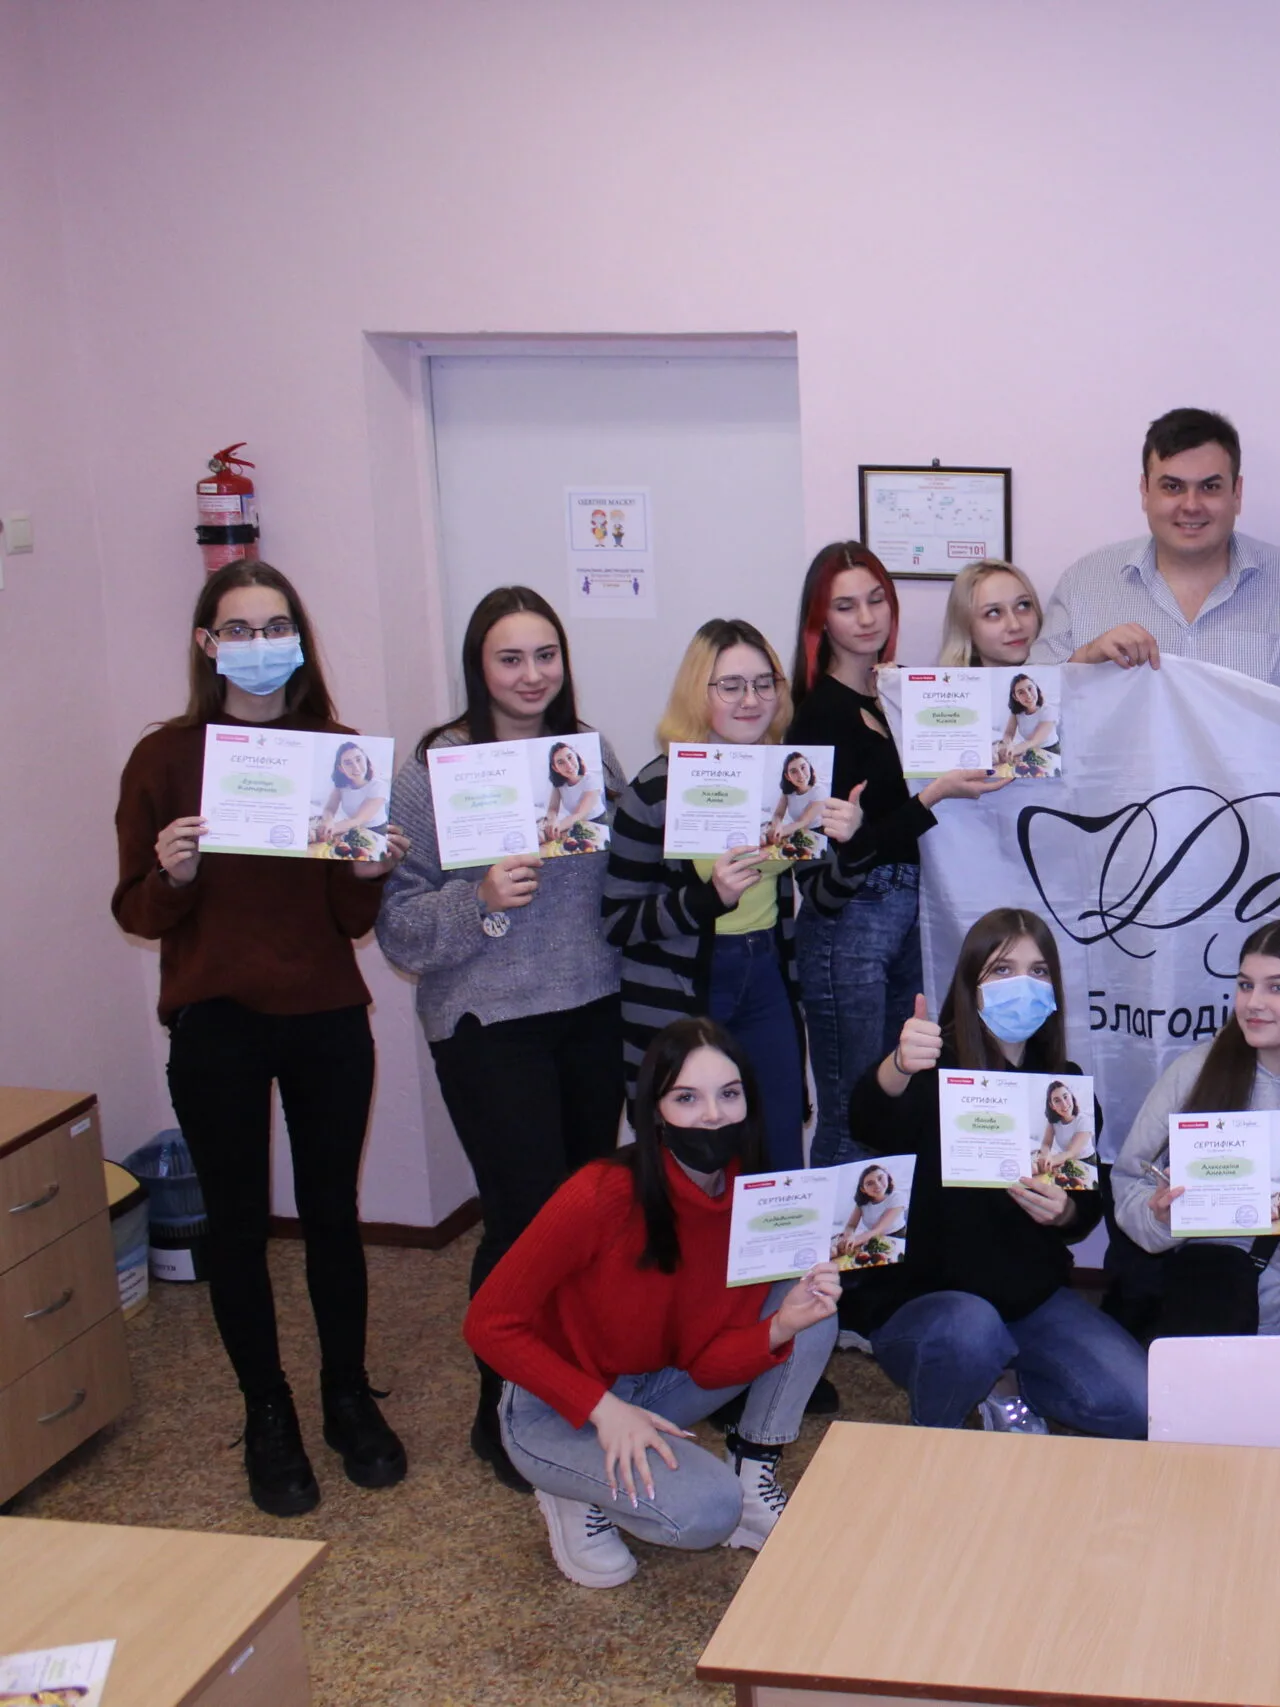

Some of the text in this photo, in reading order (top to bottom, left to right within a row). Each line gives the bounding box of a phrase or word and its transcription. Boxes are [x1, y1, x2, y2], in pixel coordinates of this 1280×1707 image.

[230, 754, 289, 767] СЕРТИФІКАТ
[691, 769, 743, 778] СЕРТИФІКАТ
[960, 1095, 1008, 1105] СЕРТИФІКАТ
[1193, 1140, 1247, 1149] СЕРТИФІКАТ
[757, 1193, 814, 1206] СЕРТИФІКАТ
